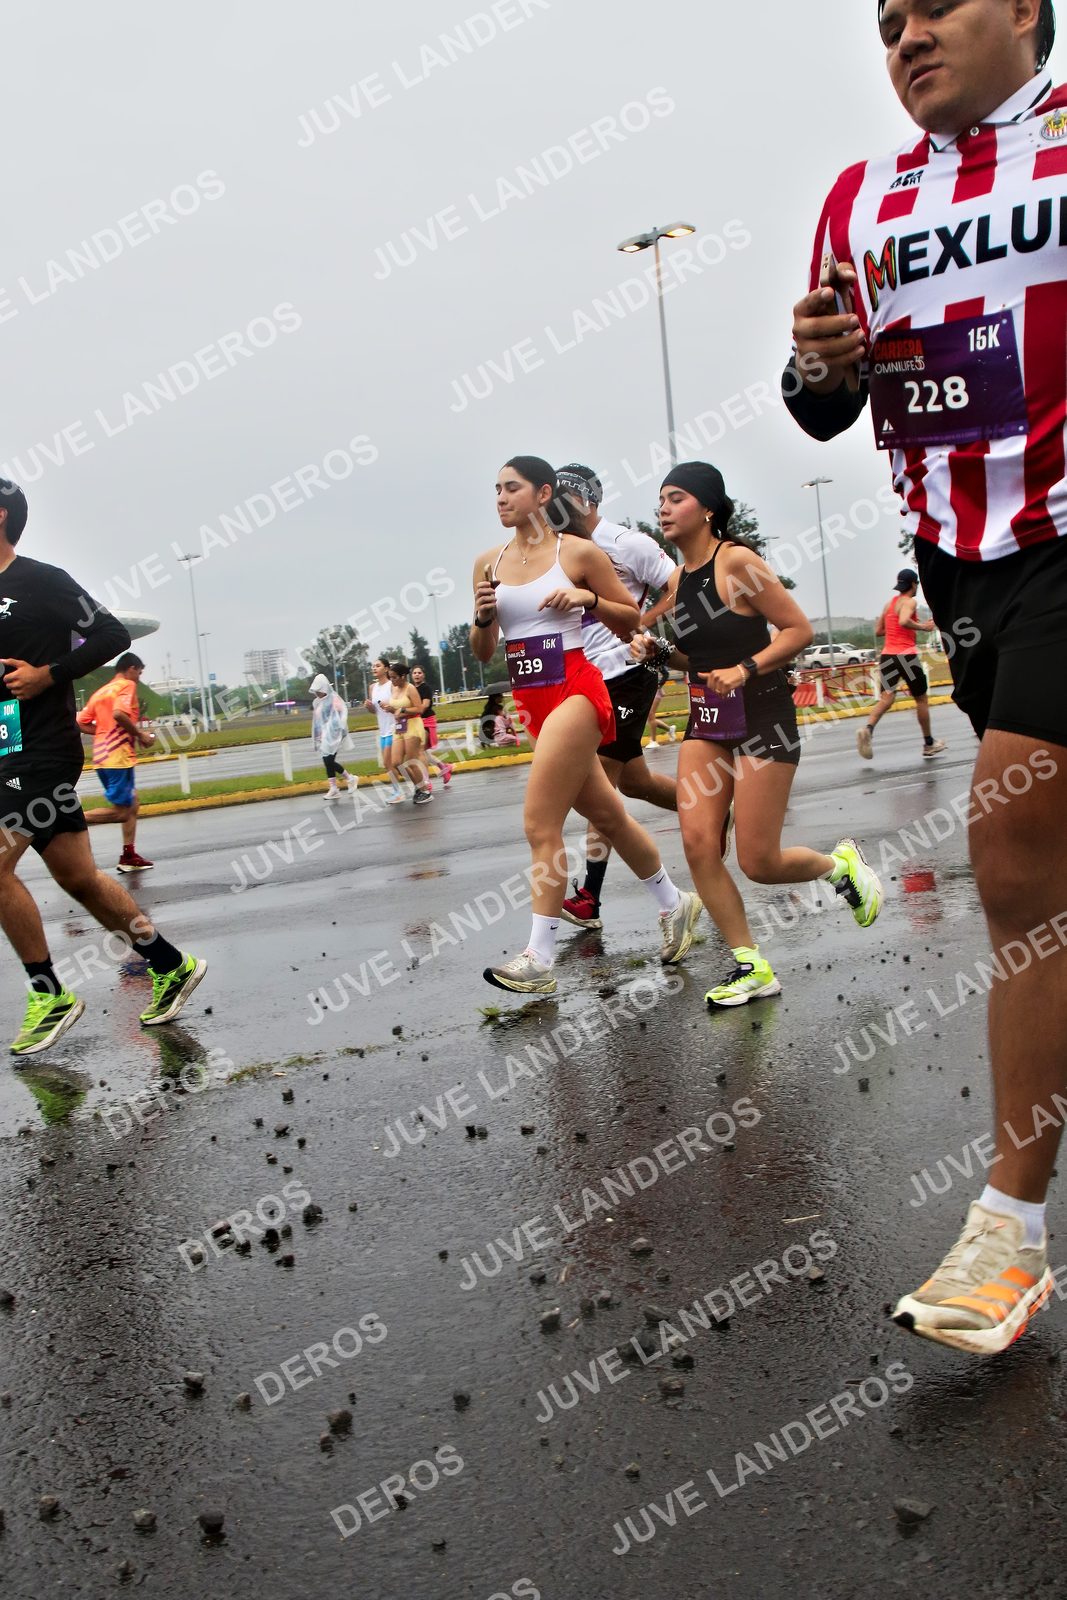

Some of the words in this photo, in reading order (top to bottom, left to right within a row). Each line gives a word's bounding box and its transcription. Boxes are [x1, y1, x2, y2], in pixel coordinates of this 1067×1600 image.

[968, 323, 1001, 352] 15K
[904, 375, 969, 414] 228
[542, 638, 556, 650] 15K
[516, 658, 543, 676] 239
[3, 703, 15, 716] 10K
[698, 706, 719, 723] 237
